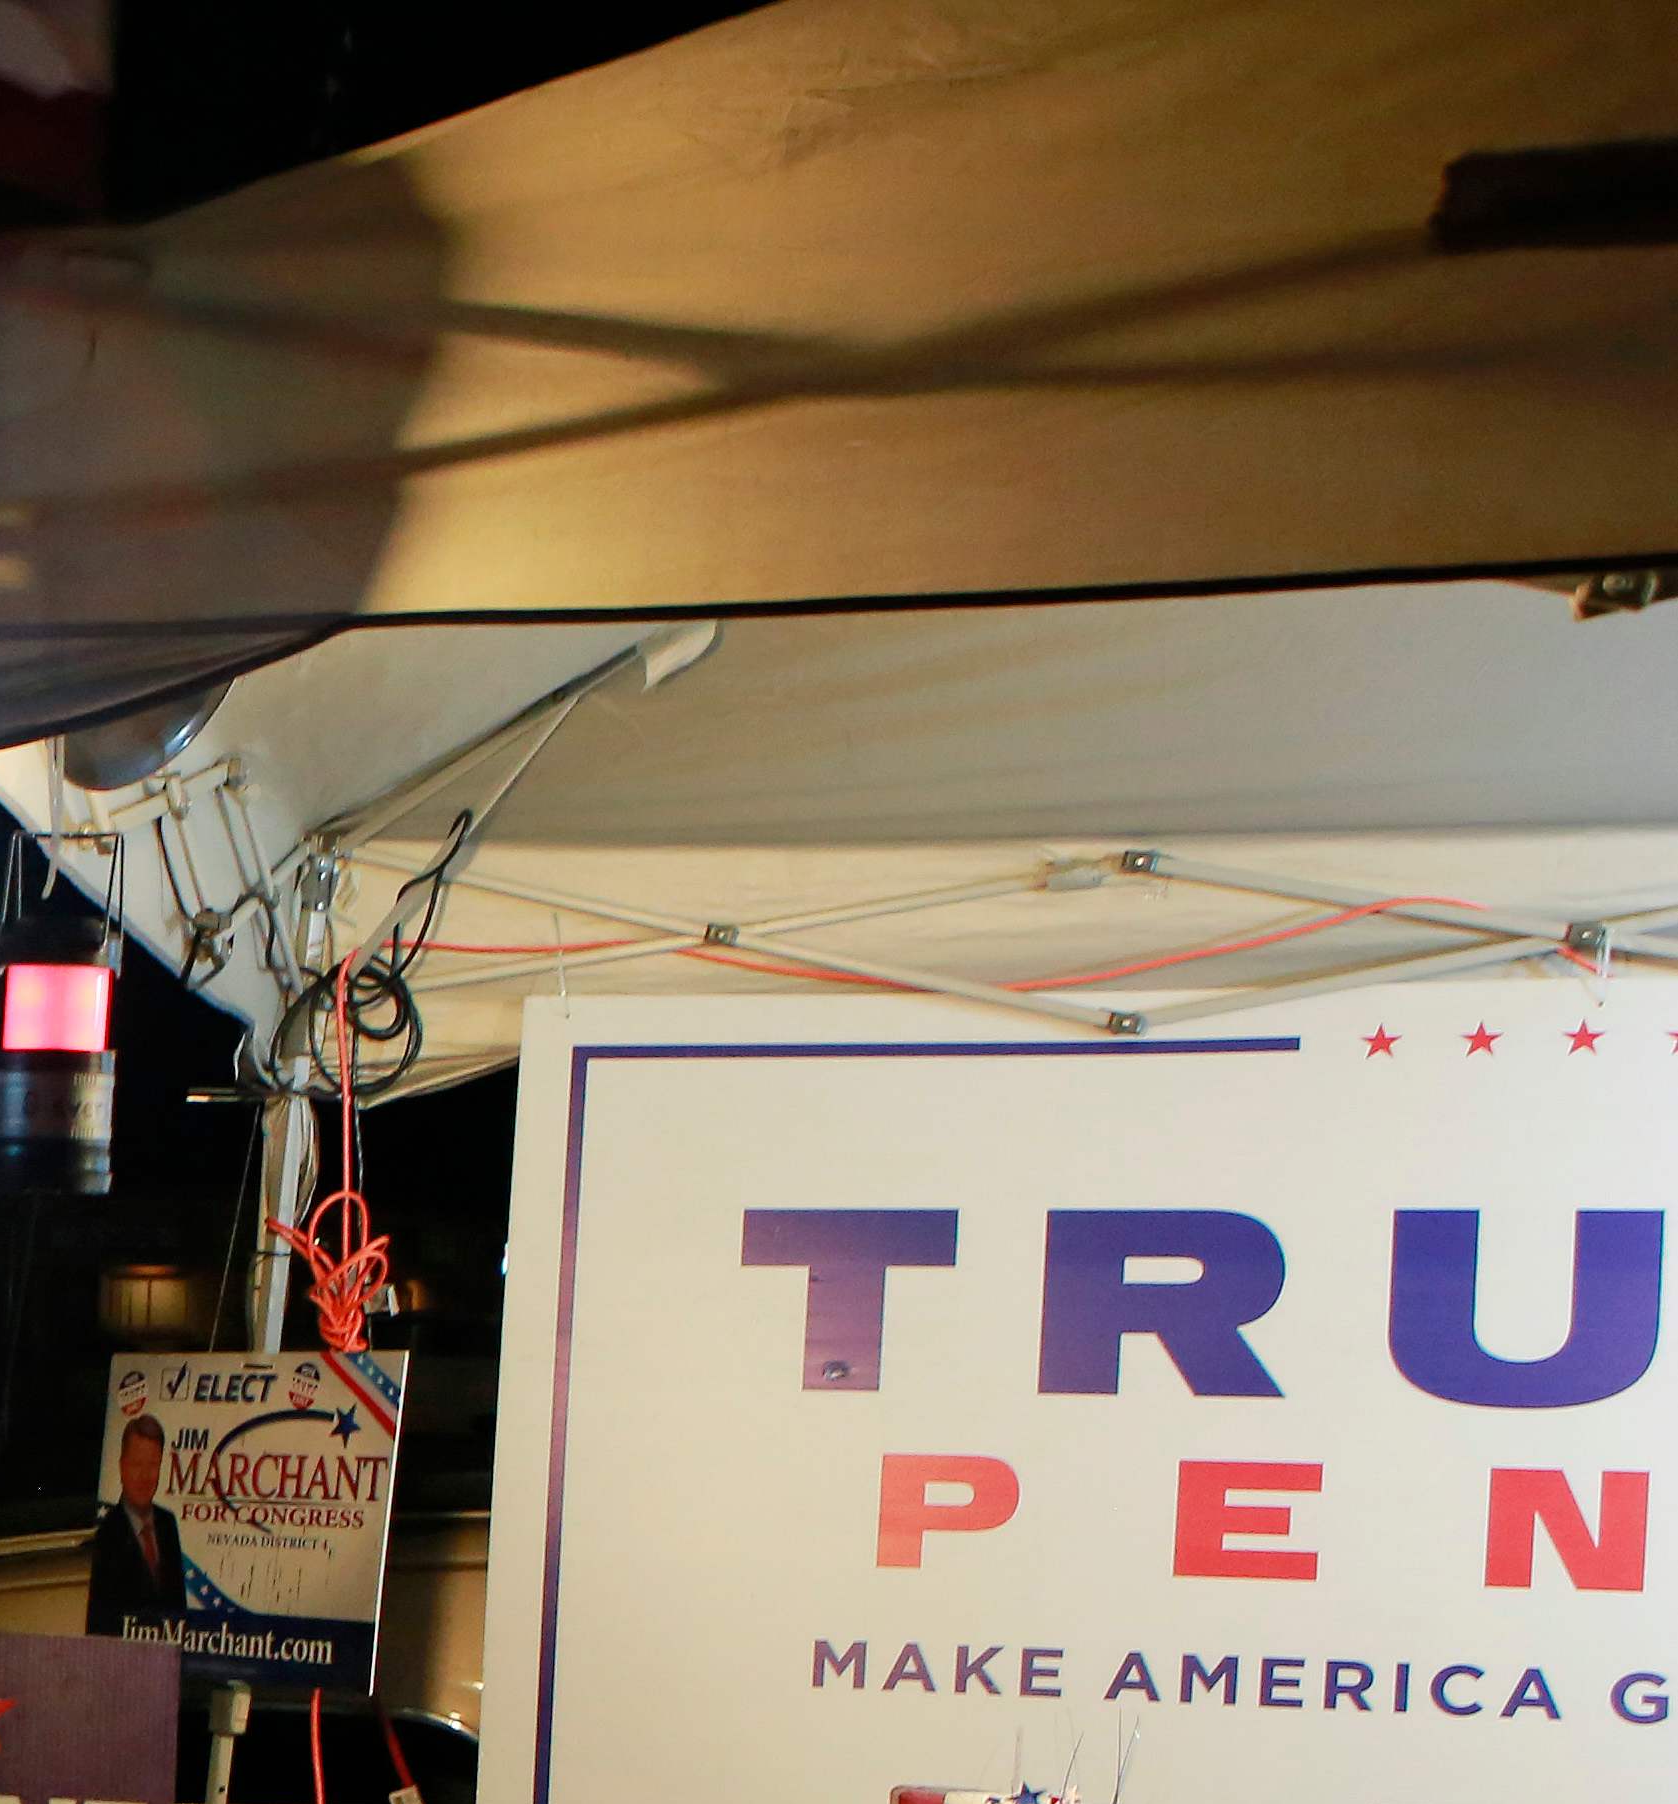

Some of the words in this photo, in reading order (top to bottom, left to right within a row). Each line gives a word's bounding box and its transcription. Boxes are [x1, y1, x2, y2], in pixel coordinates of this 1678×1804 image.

[740, 1208, 1667, 1409] TRU
[193, 1373, 278, 1404] ELECT
[171, 1428, 210, 1451] JIM
[165, 1451, 389, 1502] MARCHANT
[181, 1503, 227, 1523] FOR
[234, 1505, 365, 1530] CONGRESS
[875, 1452, 1651, 1593] PEN
[811, 1639, 1066, 1699] MAKE
[1104, 1650, 1563, 1722] AMERICA
[1610, 1671, 1670, 1725] G
